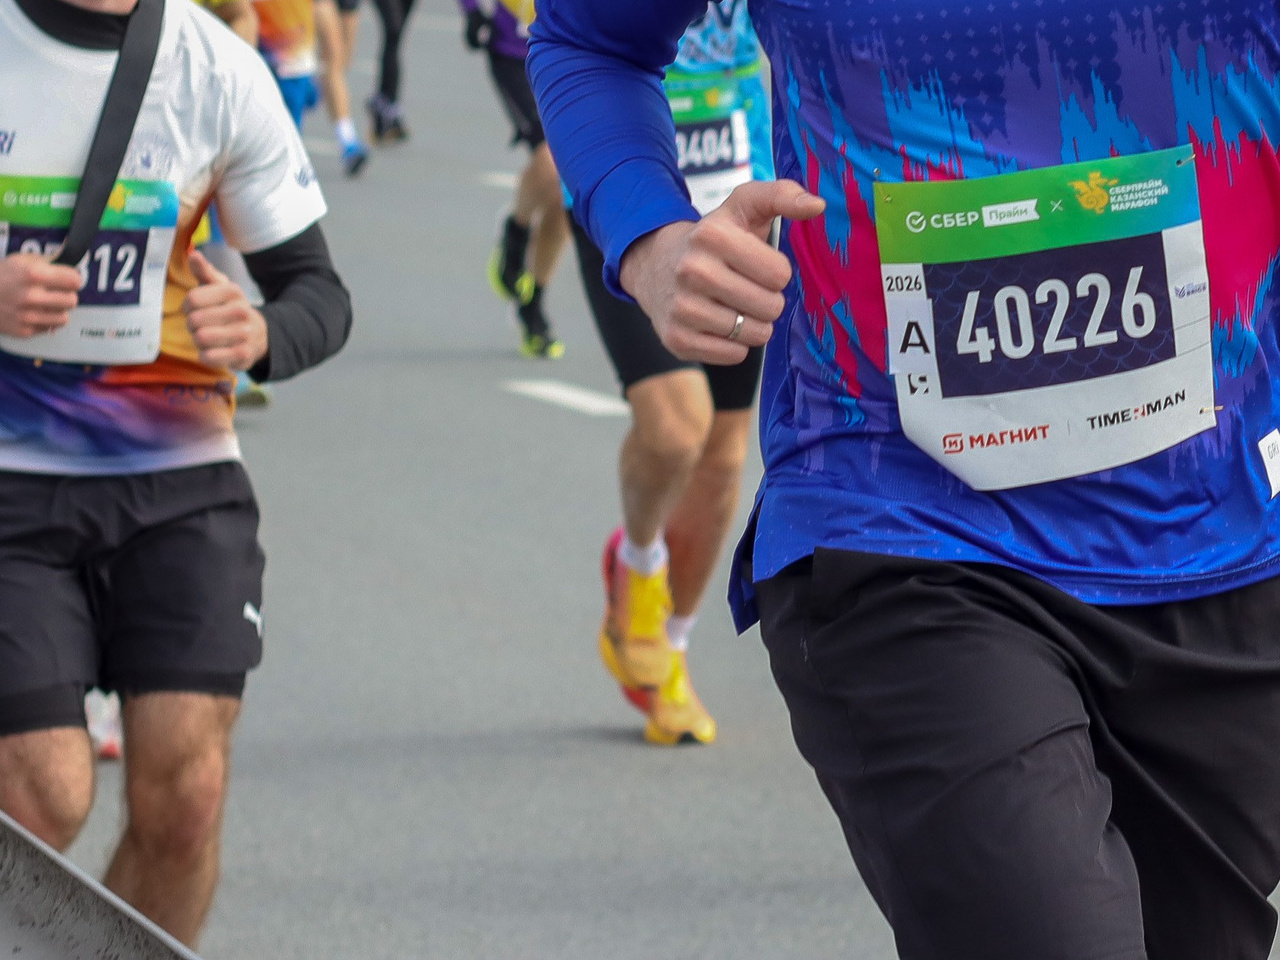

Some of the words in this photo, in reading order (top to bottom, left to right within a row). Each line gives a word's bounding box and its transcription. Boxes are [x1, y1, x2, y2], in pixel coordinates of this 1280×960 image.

[1109, 179, 1163, 195] СБЕРПРАЙМ
[1109, 184, 1169, 204] КАЗАНСКИЙ
[1111, 197, 1158, 212] МАРАФОН
[930, 211, 979, 229] СБЕР
[989, 207, 1029, 221] Прайм
[886, 275, 922, 292] 2026
[955, 266, 1157, 364] 40226
[899, 321, 931, 354] A
[969, 424, 1050, 449] МАГНИТ
